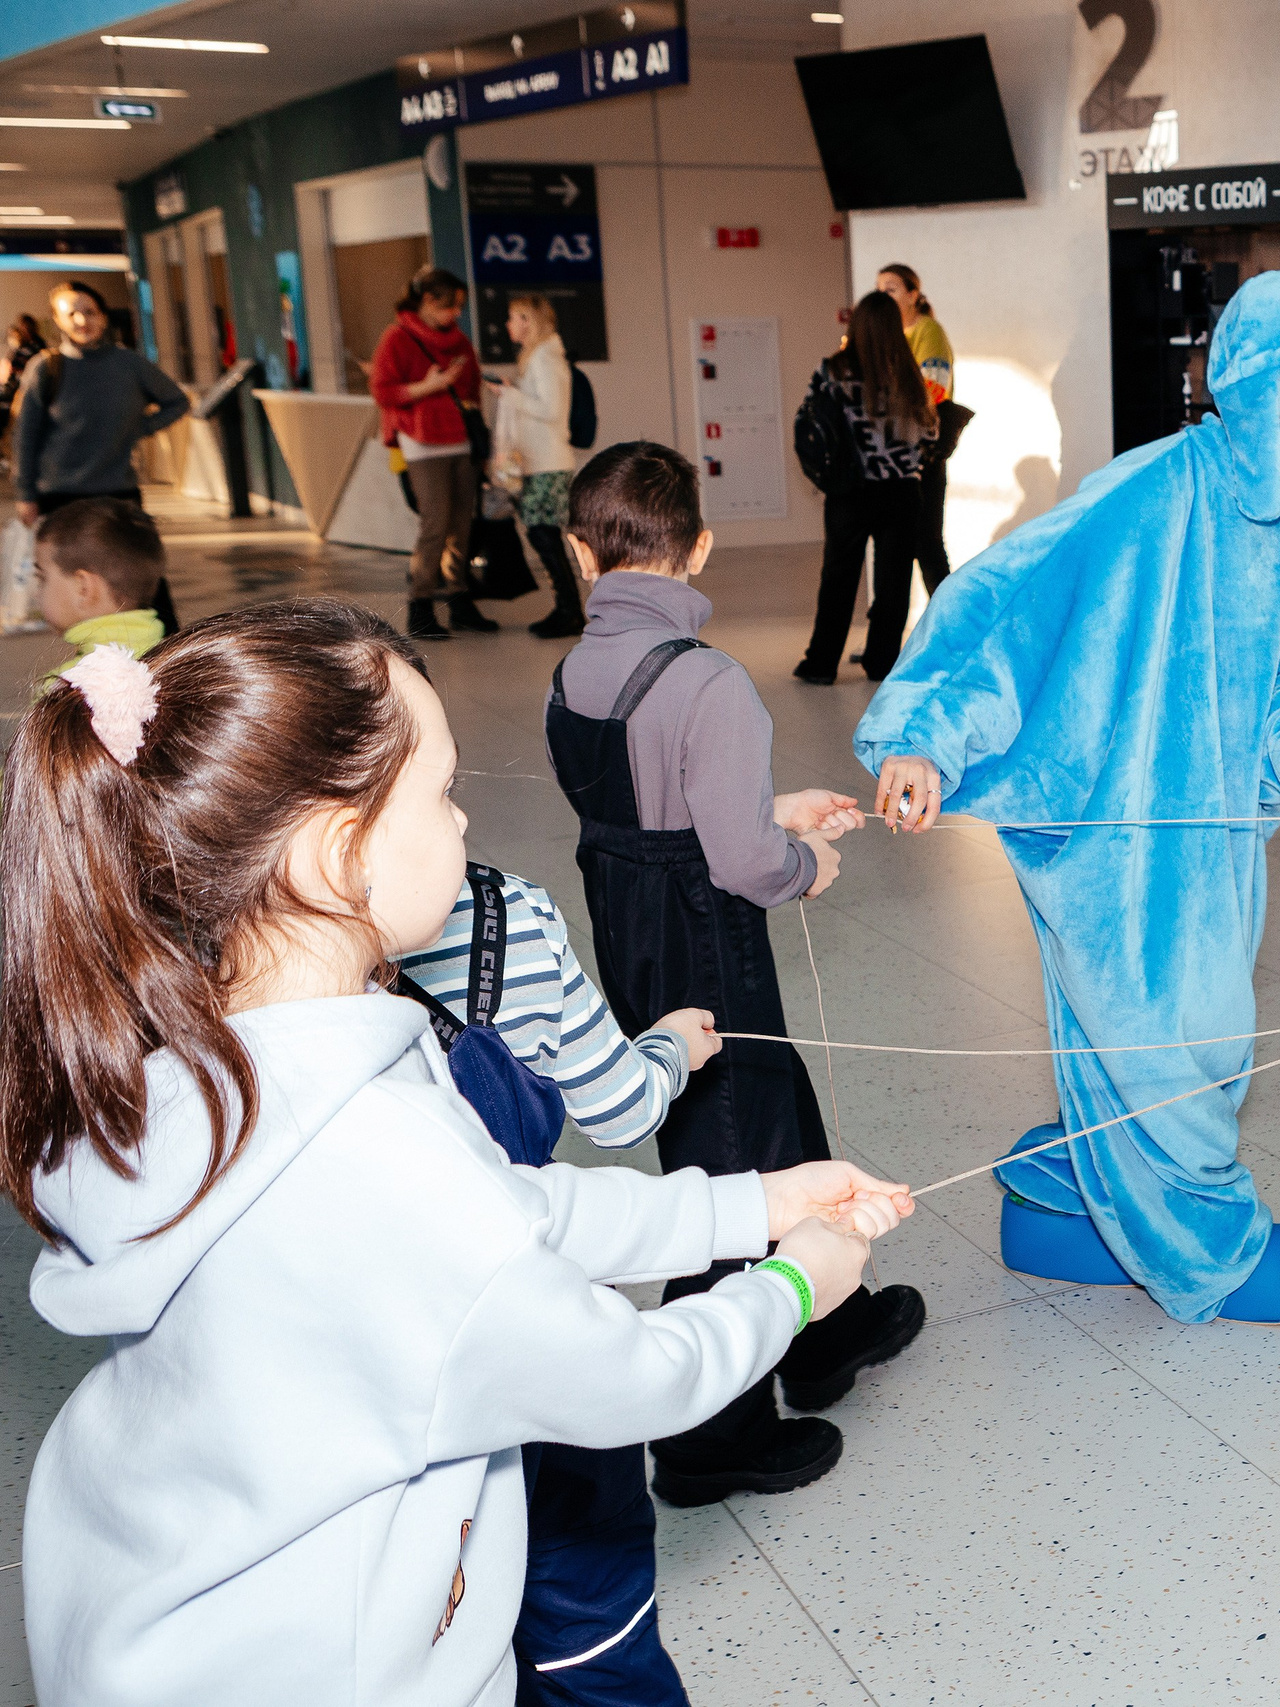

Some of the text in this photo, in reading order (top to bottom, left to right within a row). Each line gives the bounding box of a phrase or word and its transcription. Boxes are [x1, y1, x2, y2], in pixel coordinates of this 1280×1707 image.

[1078, 0, 1164, 135] 2
[1080, 146, 1163, 177] ЭТА
[1142, 184, 1189, 213] КОФЕ
[1211, 176, 1267, 210] СОБОЙ
[482, 233, 593, 263] A2 A3
